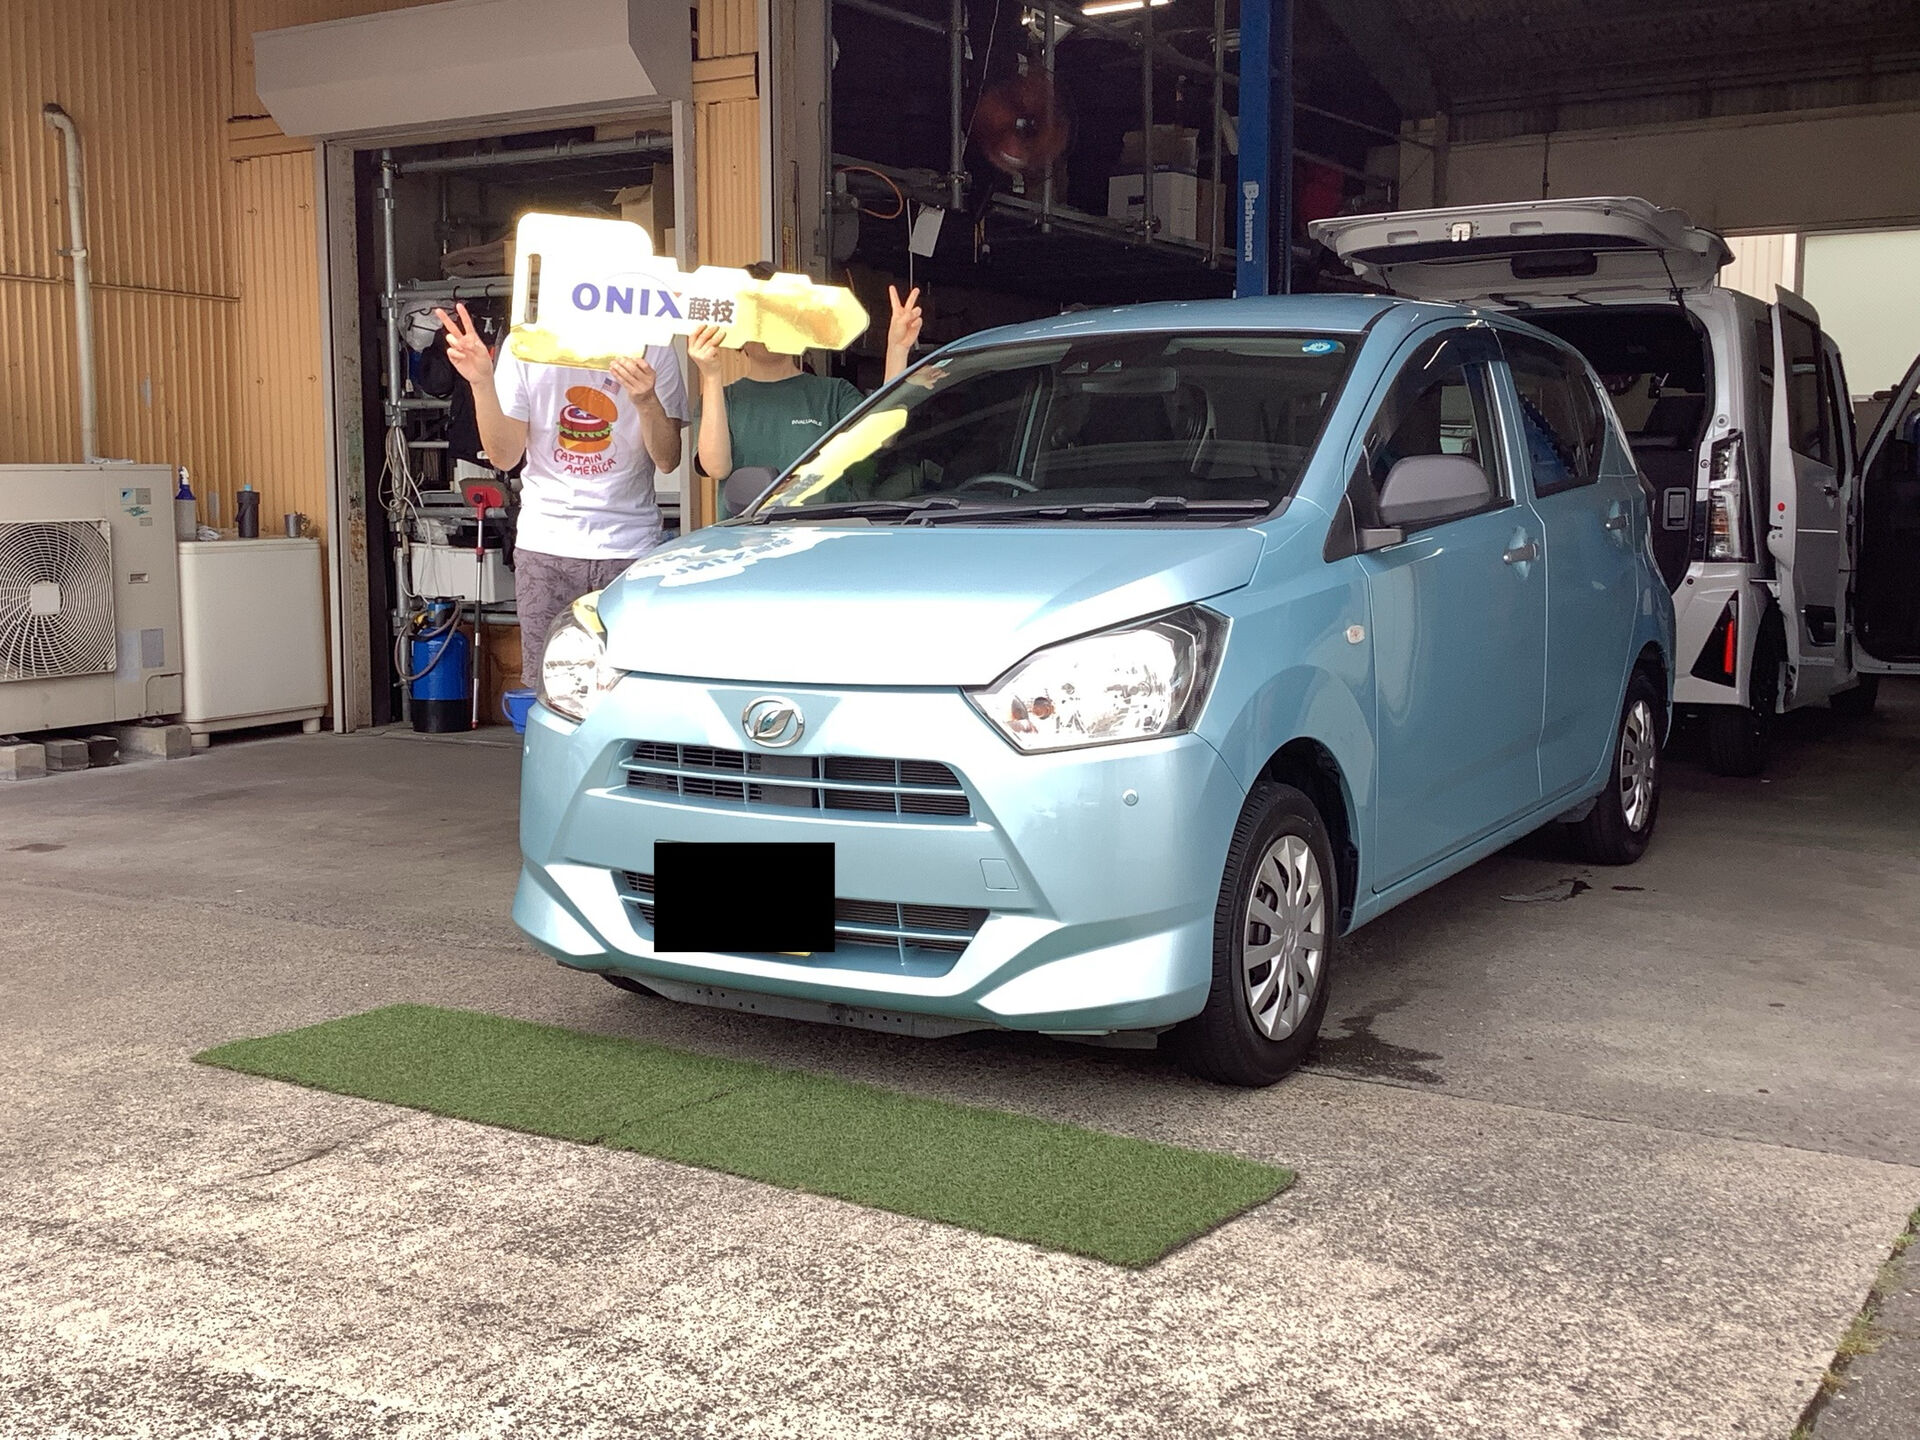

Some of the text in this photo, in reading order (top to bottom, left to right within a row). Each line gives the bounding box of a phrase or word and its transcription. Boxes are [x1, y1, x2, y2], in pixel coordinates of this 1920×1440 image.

[1243, 181, 1259, 262] Bishamon
[572, 283, 735, 324] ONIX 藤枝
[553, 448, 602, 465] CAPTAIN
[564, 458, 617, 475] AMERICA
